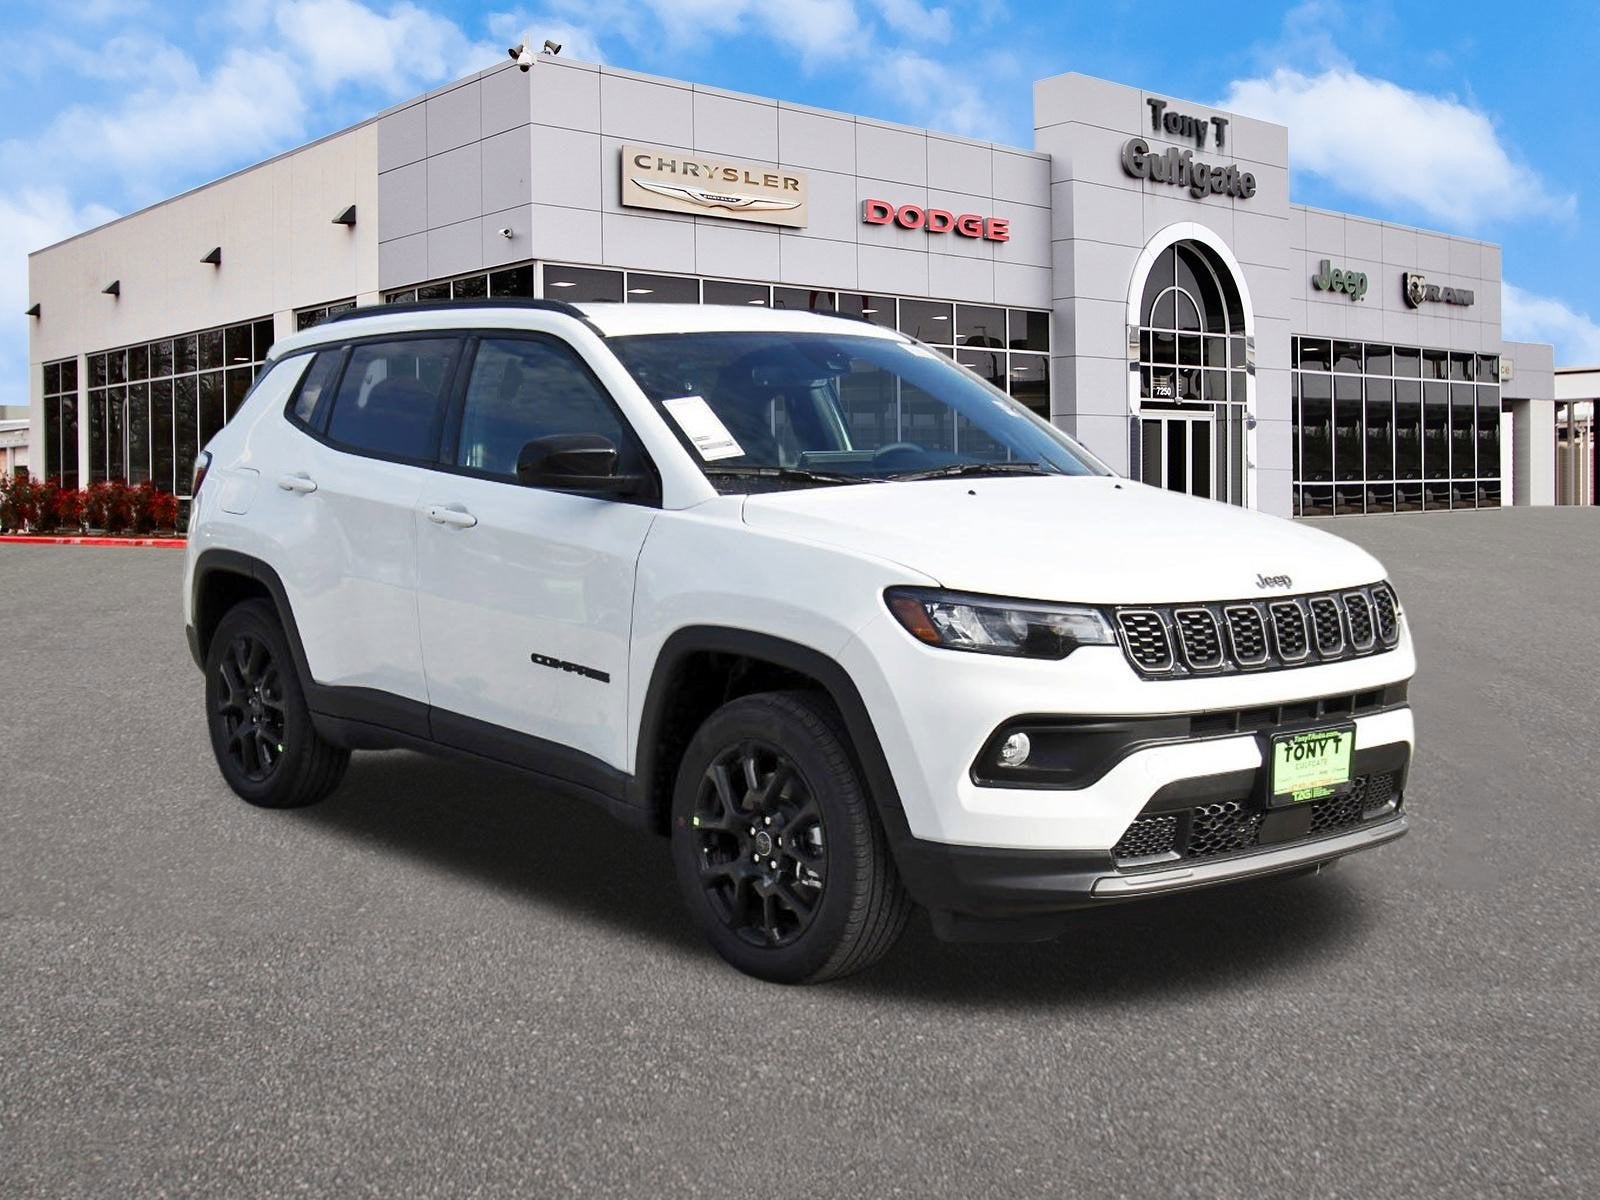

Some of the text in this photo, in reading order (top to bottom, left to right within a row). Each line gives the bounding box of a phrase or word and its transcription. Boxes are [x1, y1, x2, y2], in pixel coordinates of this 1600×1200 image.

[1146, 97, 1229, 148] Tony T
[633, 154, 800, 192] CHRYSLER
[1121, 137, 1257, 199] Gulfgate
[862, 198, 1010, 242] DODGE
[1312, 259, 1368, 301] Jeep
[1423, 284, 1475, 306] RAM
[1156, 386, 1172, 396] 7250
[1256, 573, 1292, 590] Jeep
[1284, 737, 1342, 763] TONY T
